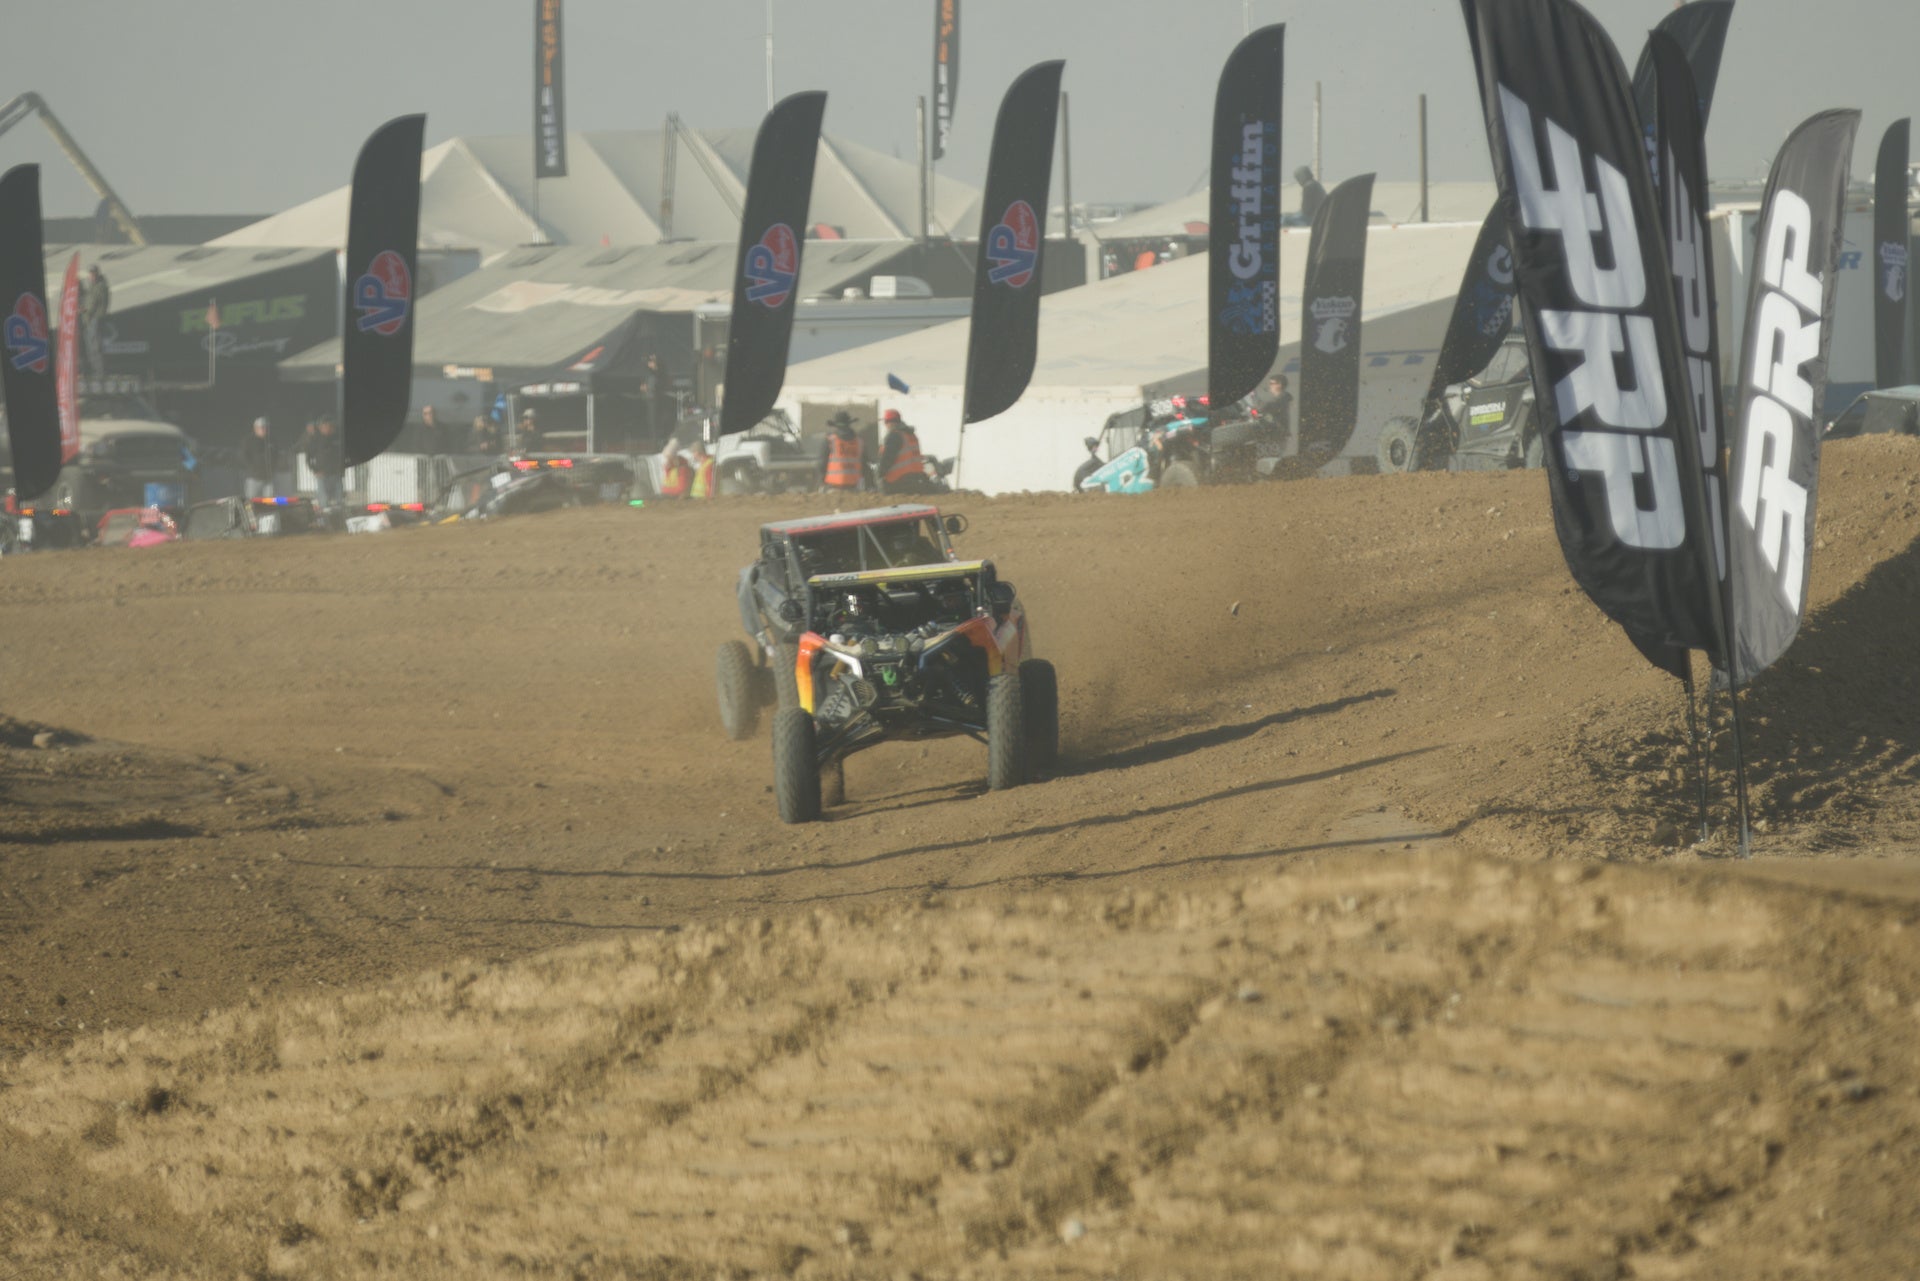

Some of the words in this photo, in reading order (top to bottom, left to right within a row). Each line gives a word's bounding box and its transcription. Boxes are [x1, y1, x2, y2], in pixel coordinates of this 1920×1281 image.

[1229, 120, 1264, 280] Griffin
[1264, 122, 1276, 273] RADIATOR
[354, 273, 407, 332] VP
[745, 243, 795, 302] VP
[987, 224, 1037, 283] VP
[4, 314, 48, 371] VP
[1498, 81, 1686, 550] PRP
[1739, 188, 1824, 615] PRP
